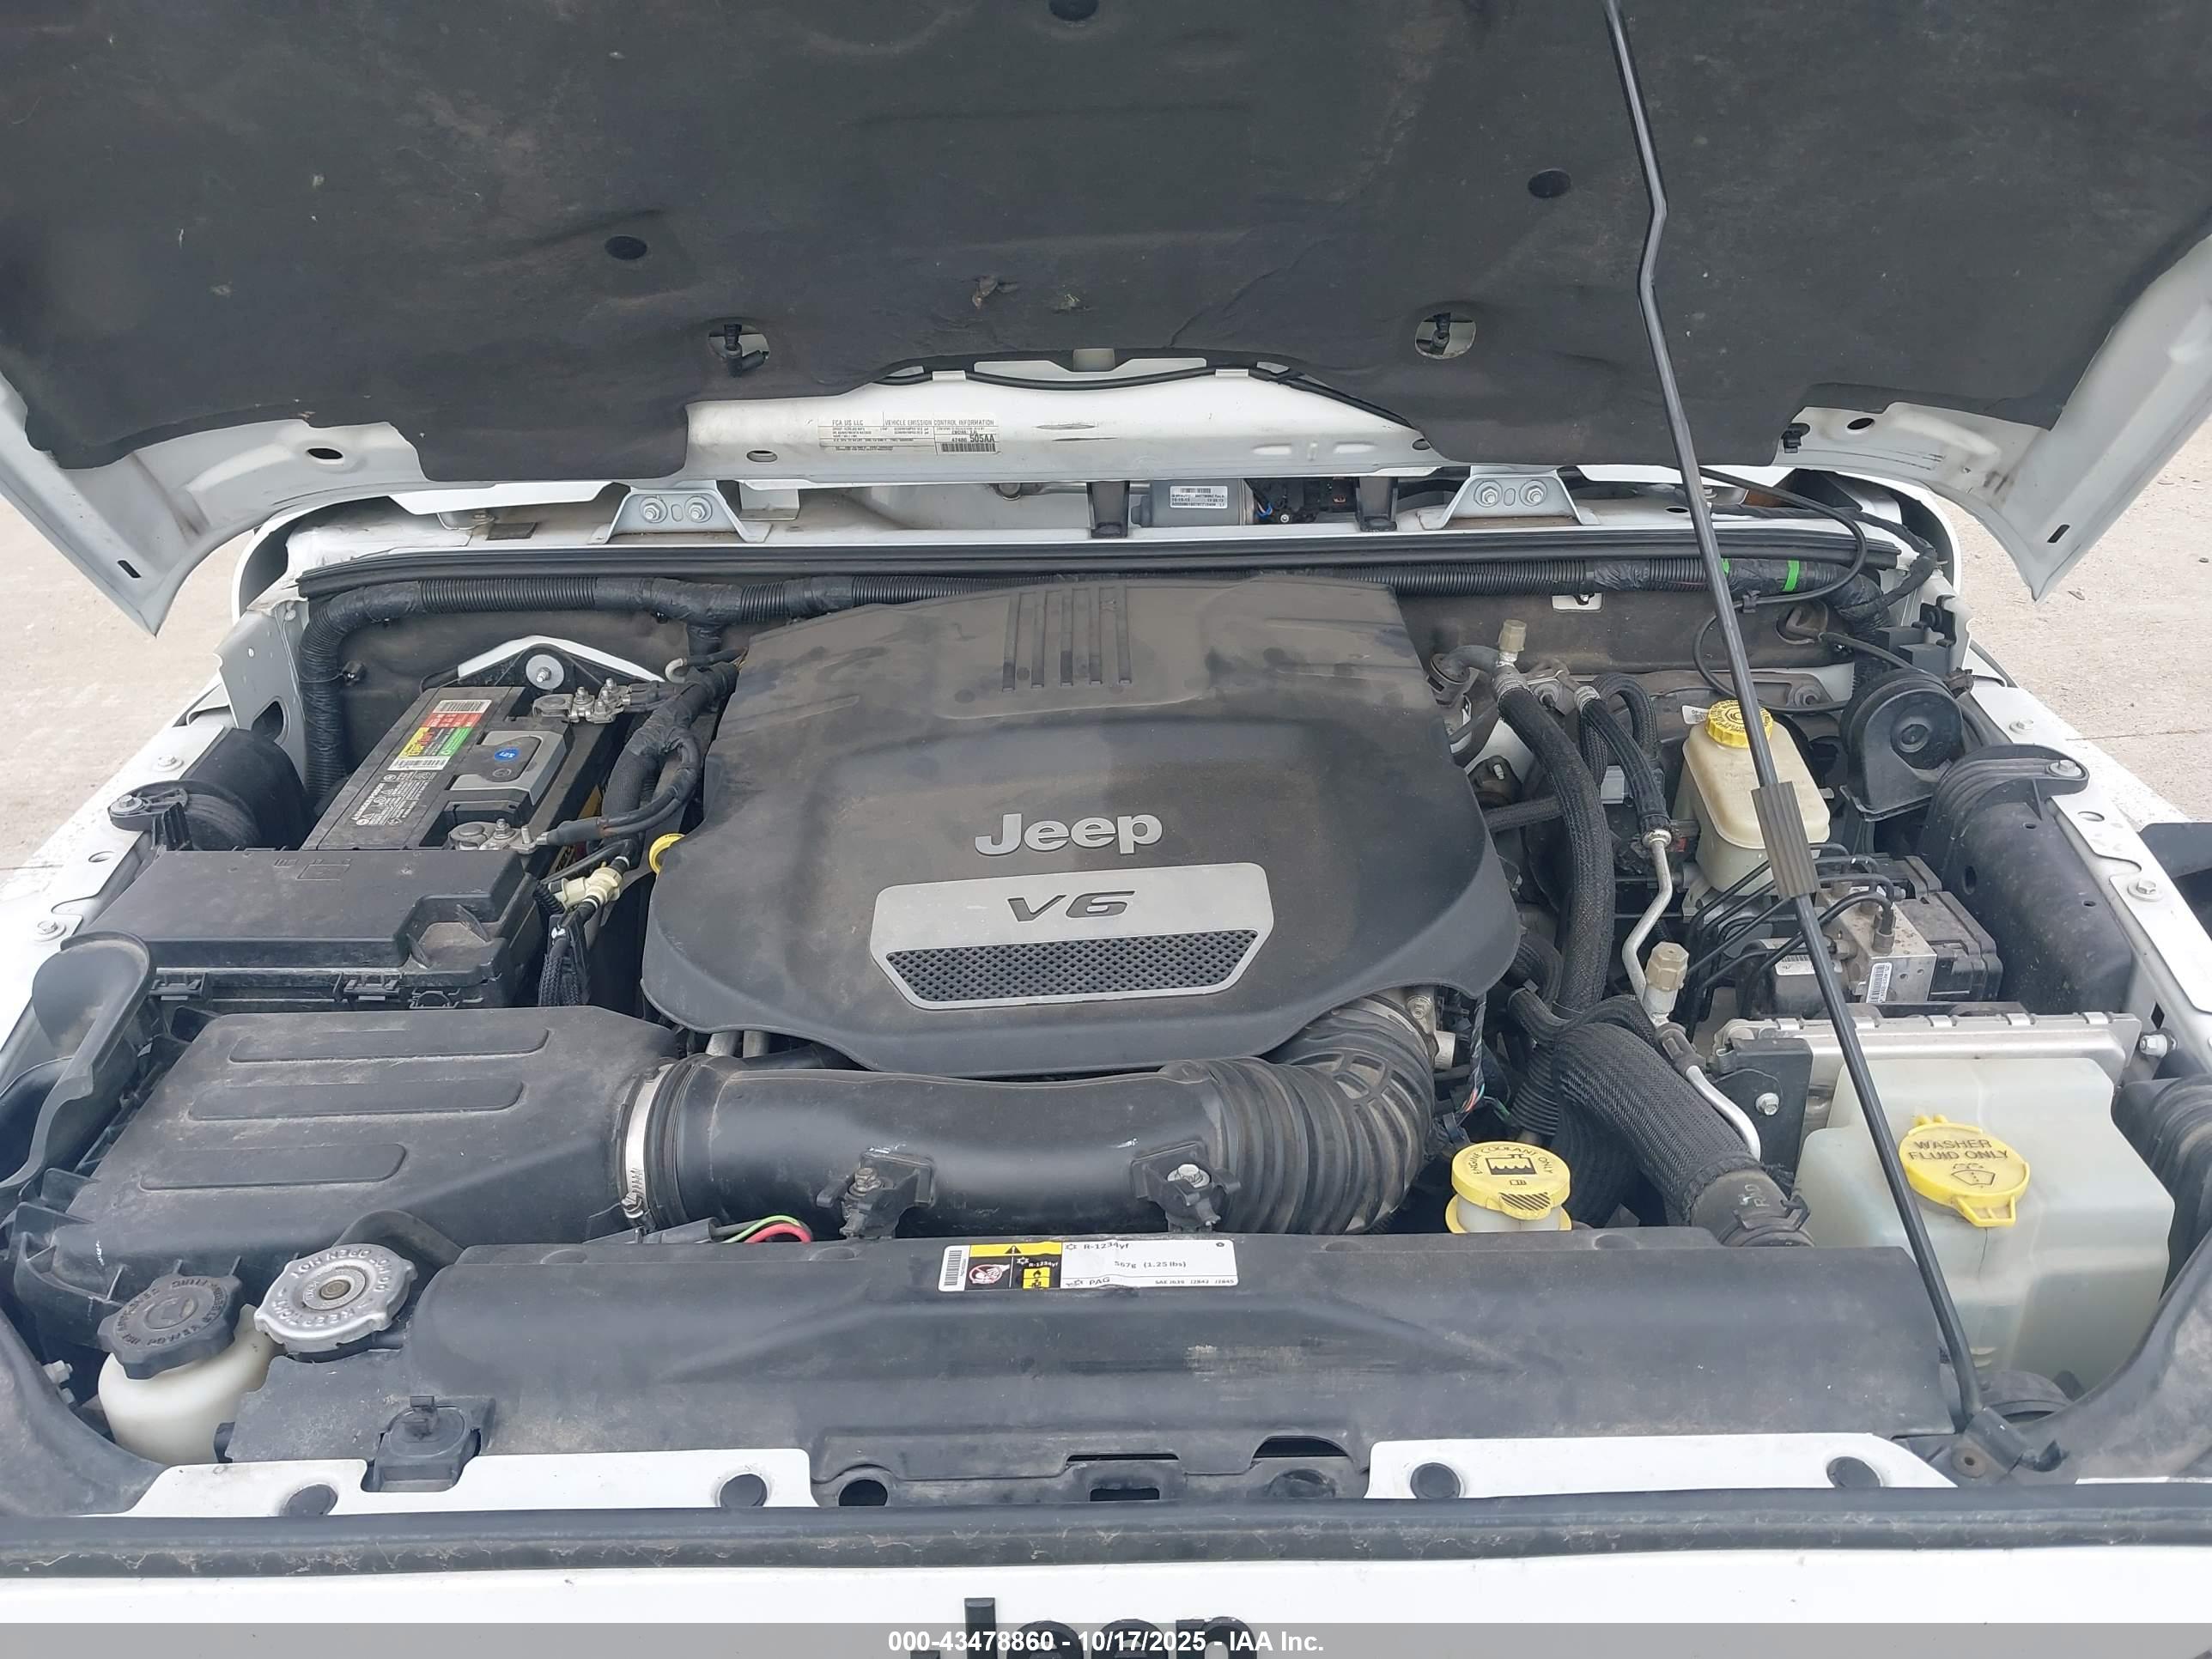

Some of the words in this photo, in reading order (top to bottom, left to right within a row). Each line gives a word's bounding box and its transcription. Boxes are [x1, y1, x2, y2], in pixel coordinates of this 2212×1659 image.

[969, 434, 994, 443] 505AA
[975, 812, 1163, 856] Jeep
[1006, 890, 1136, 922] V6
[1914, 1139, 1992, 1150] WASHER
[1481, 1146, 1538, 1156] COOLANT
[1538, 1157, 1554, 1174] ONLY
[1908, 1151, 1960, 1161] FLUID
[1965, 1149, 2009, 1160] ONLY
[1084, 1242, 1129, 1250] R-1234yf
[326, 1249, 372, 1261] OPEN
[1115, 1261, 1137, 1269] 567g
[1088, 1277, 1110, 1285] PAG
[301, 1308, 357, 1328] KEEP
[146, 1324, 203, 1346] POWER
